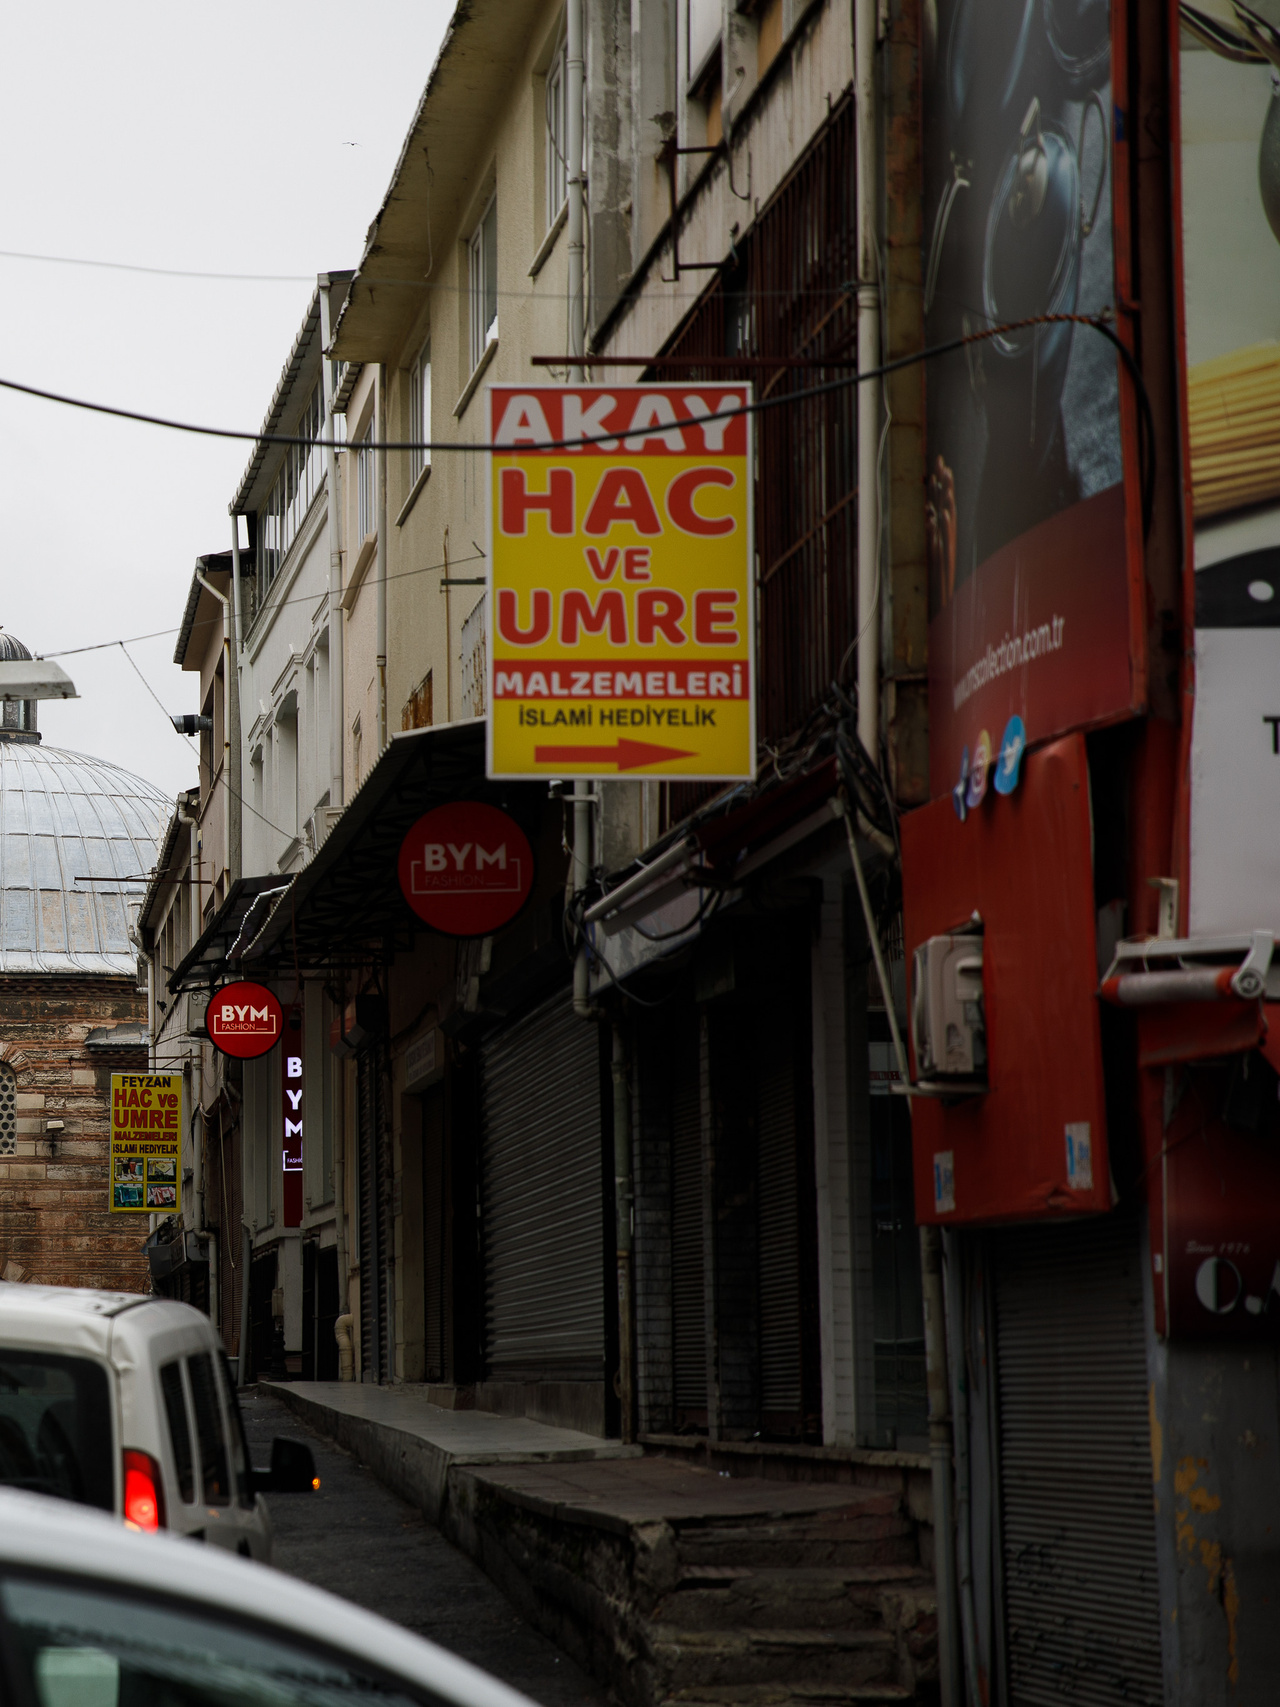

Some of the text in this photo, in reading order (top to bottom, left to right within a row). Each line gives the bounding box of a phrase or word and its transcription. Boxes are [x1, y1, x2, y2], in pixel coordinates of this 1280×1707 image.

[494, 394, 741, 452] AKAY
[499, 466, 737, 538] HAC
[584, 547, 652, 583] VE
[496, 588, 740, 647] UMRE
[495, 664, 742, 696] MALZEMELERİ
[517, 704, 716, 726] İSLAMİ HEDİYELİK
[423, 842, 508, 872] BYM
[425, 874, 484, 887] FASHION
[221, 1005, 268, 1022] BYM
[122, 1076, 171, 1088] FEYZAN
[114, 1088, 178, 1108] HAC ve
[114, 1110, 178, 1129] UMRE
